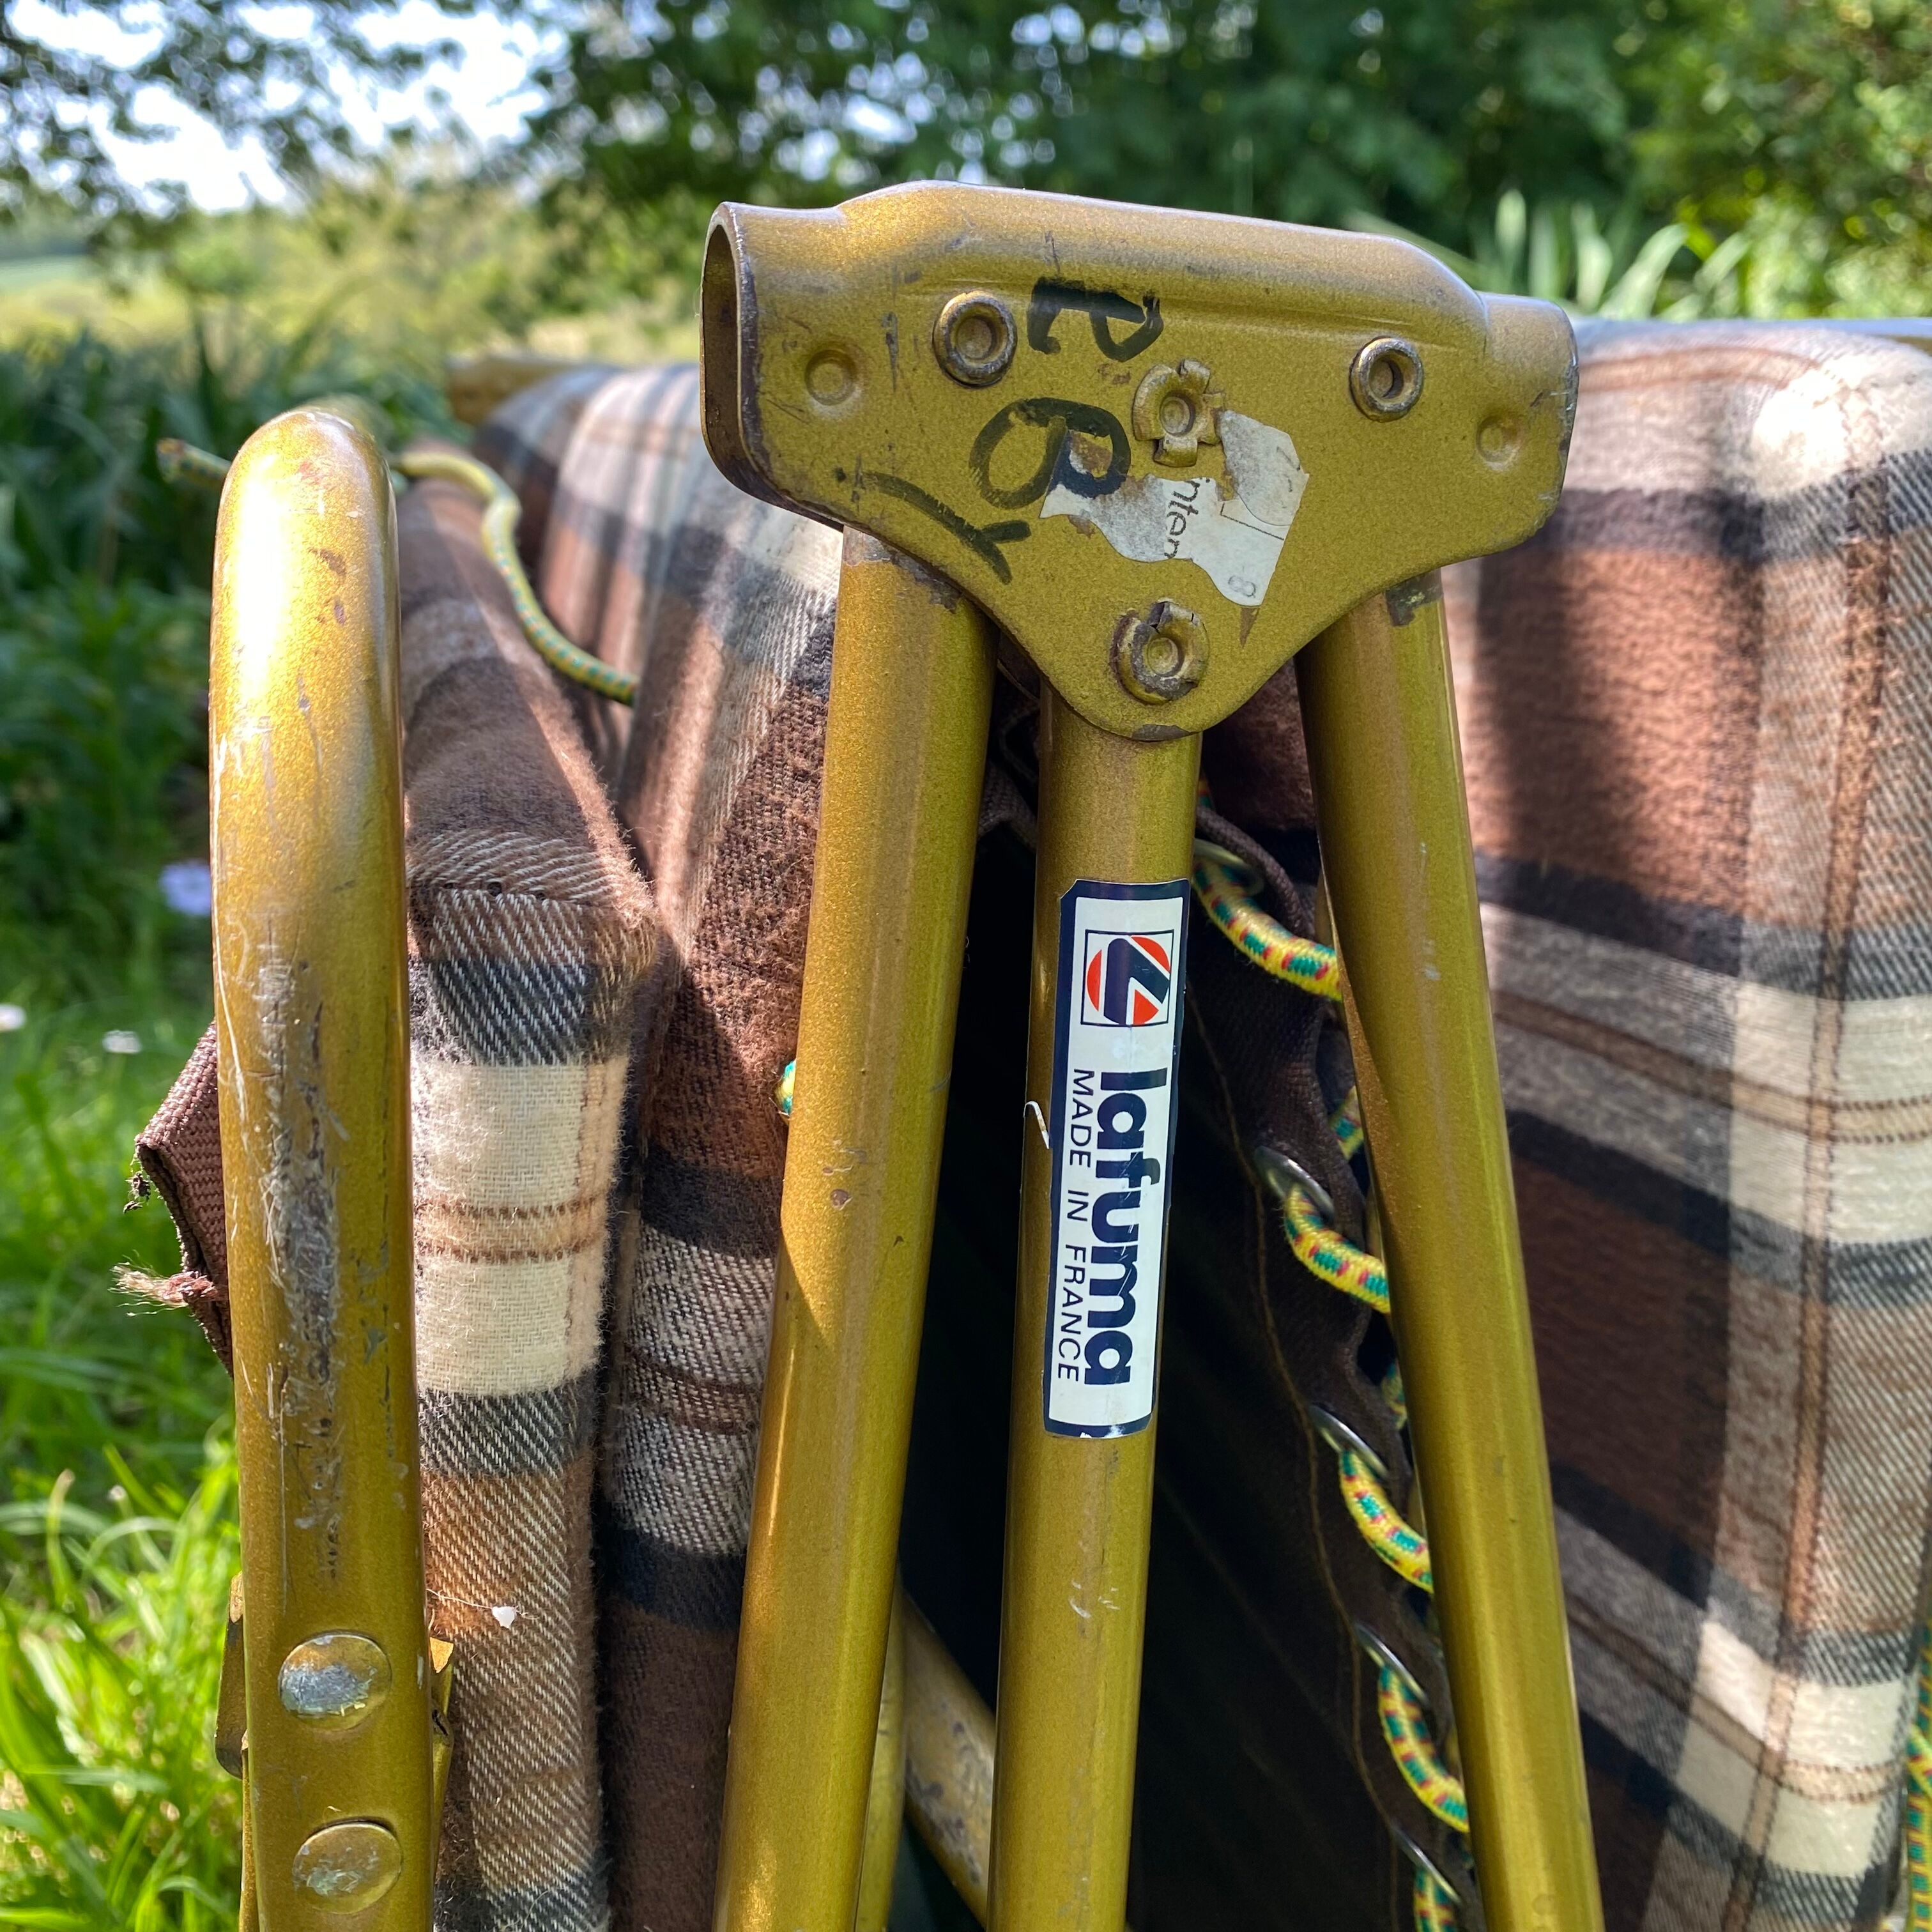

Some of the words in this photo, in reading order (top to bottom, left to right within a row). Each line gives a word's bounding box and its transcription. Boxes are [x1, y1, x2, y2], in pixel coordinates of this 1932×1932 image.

[1070, 1068, 1095, 1169] MADE
[1066, 1189, 1089, 1222] IN
[1084, 1067, 1168, 1385] lafuma
[1057, 1243, 1087, 1383] FRANCE
